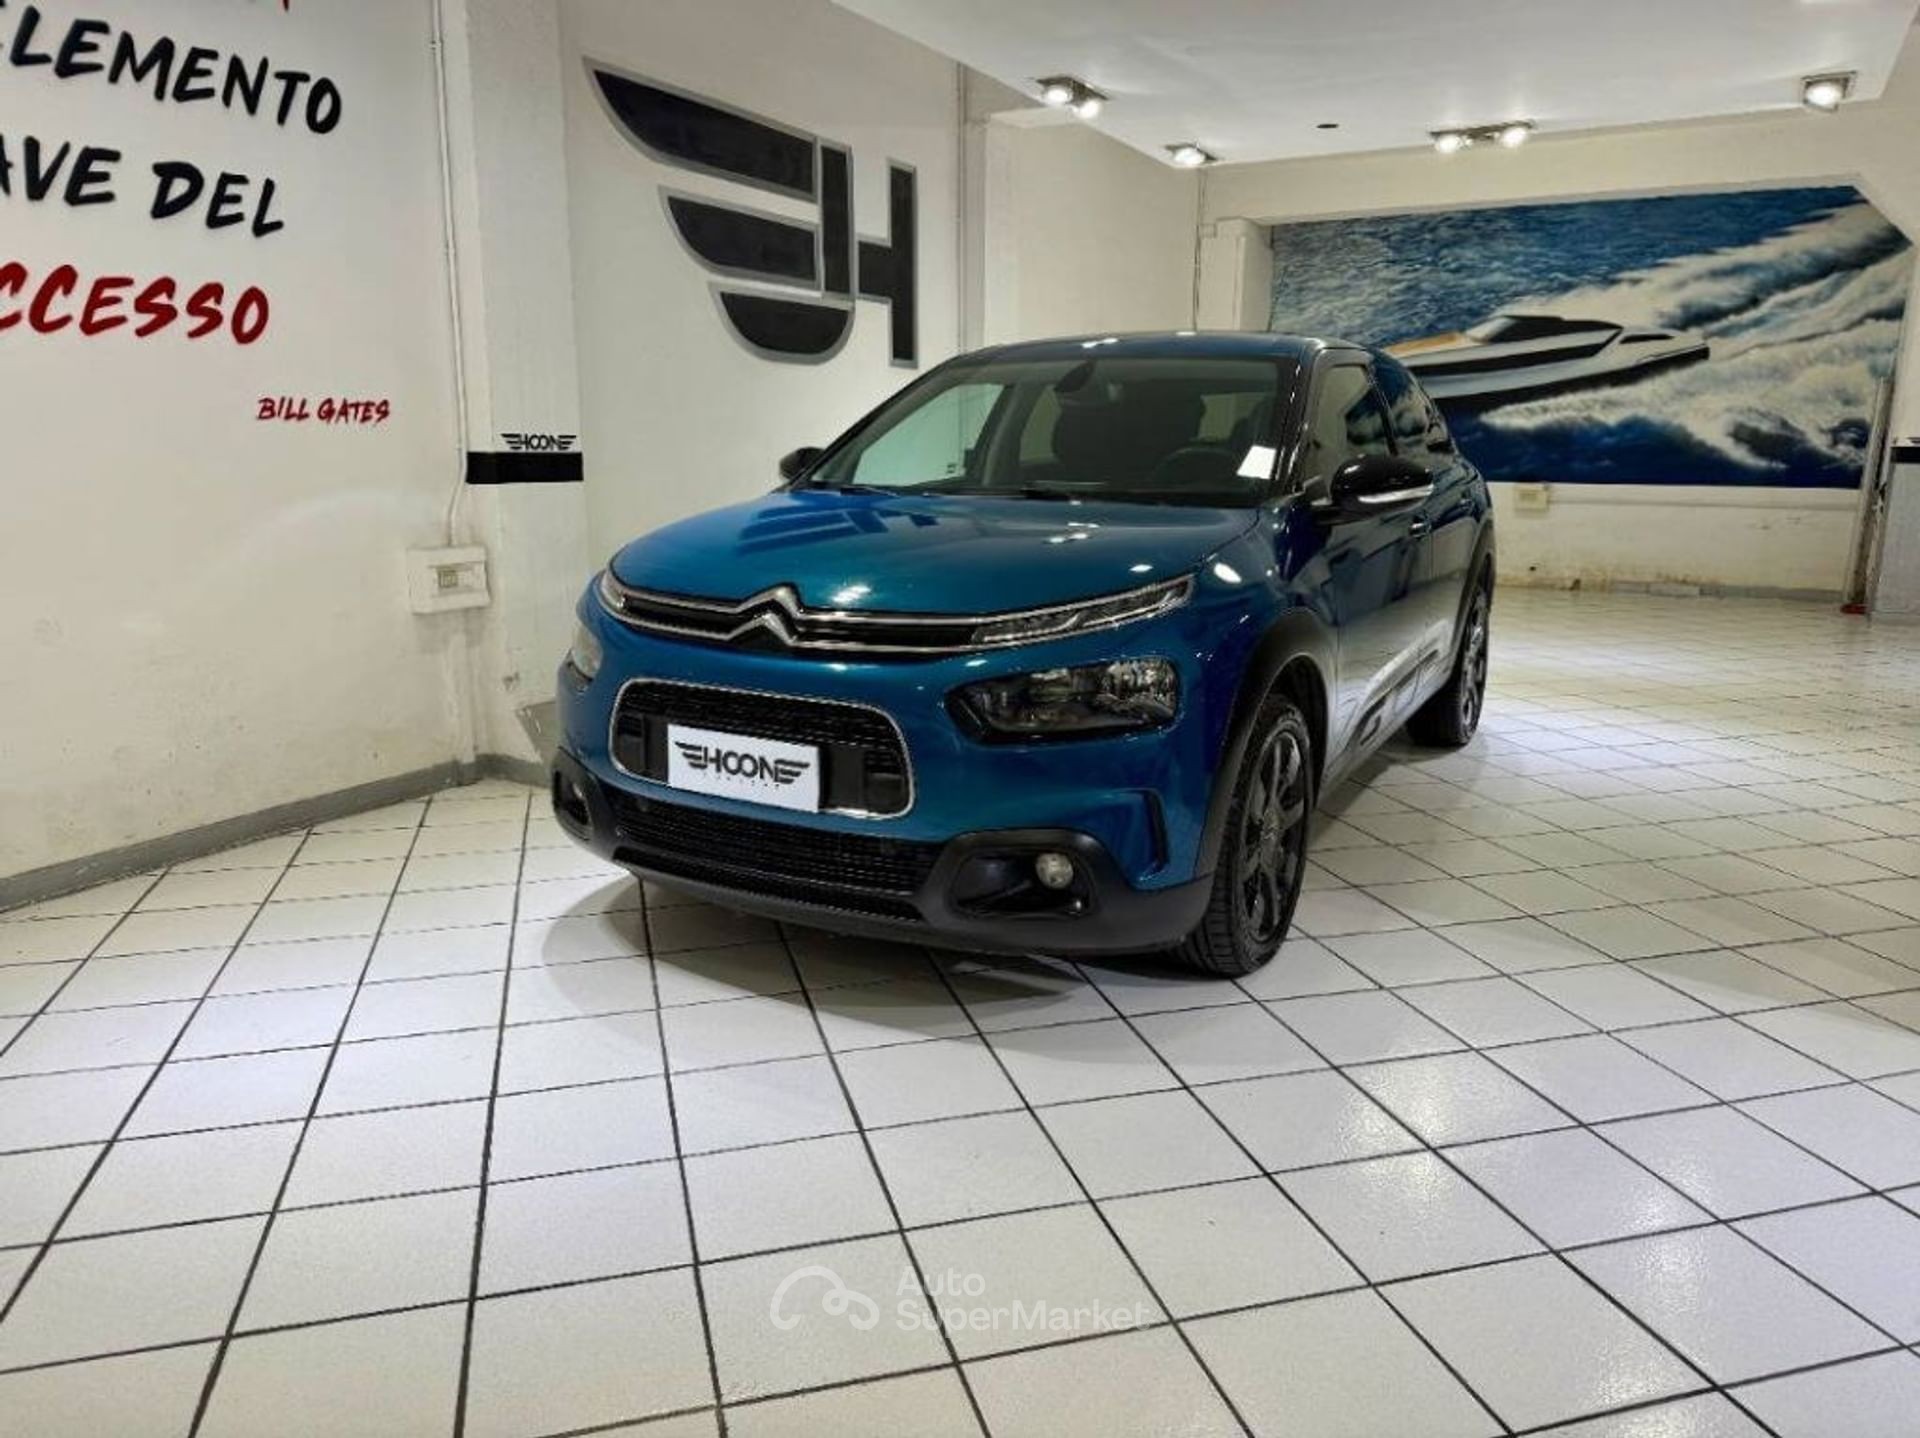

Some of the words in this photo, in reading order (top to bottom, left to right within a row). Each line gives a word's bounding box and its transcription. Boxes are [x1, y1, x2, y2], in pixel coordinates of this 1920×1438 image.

[0, 0, 342, 135] LEMENTO
[150, 161, 284, 238] DEL
[257, 396, 310, 421] BILL
[317, 397, 390, 424] GATES
